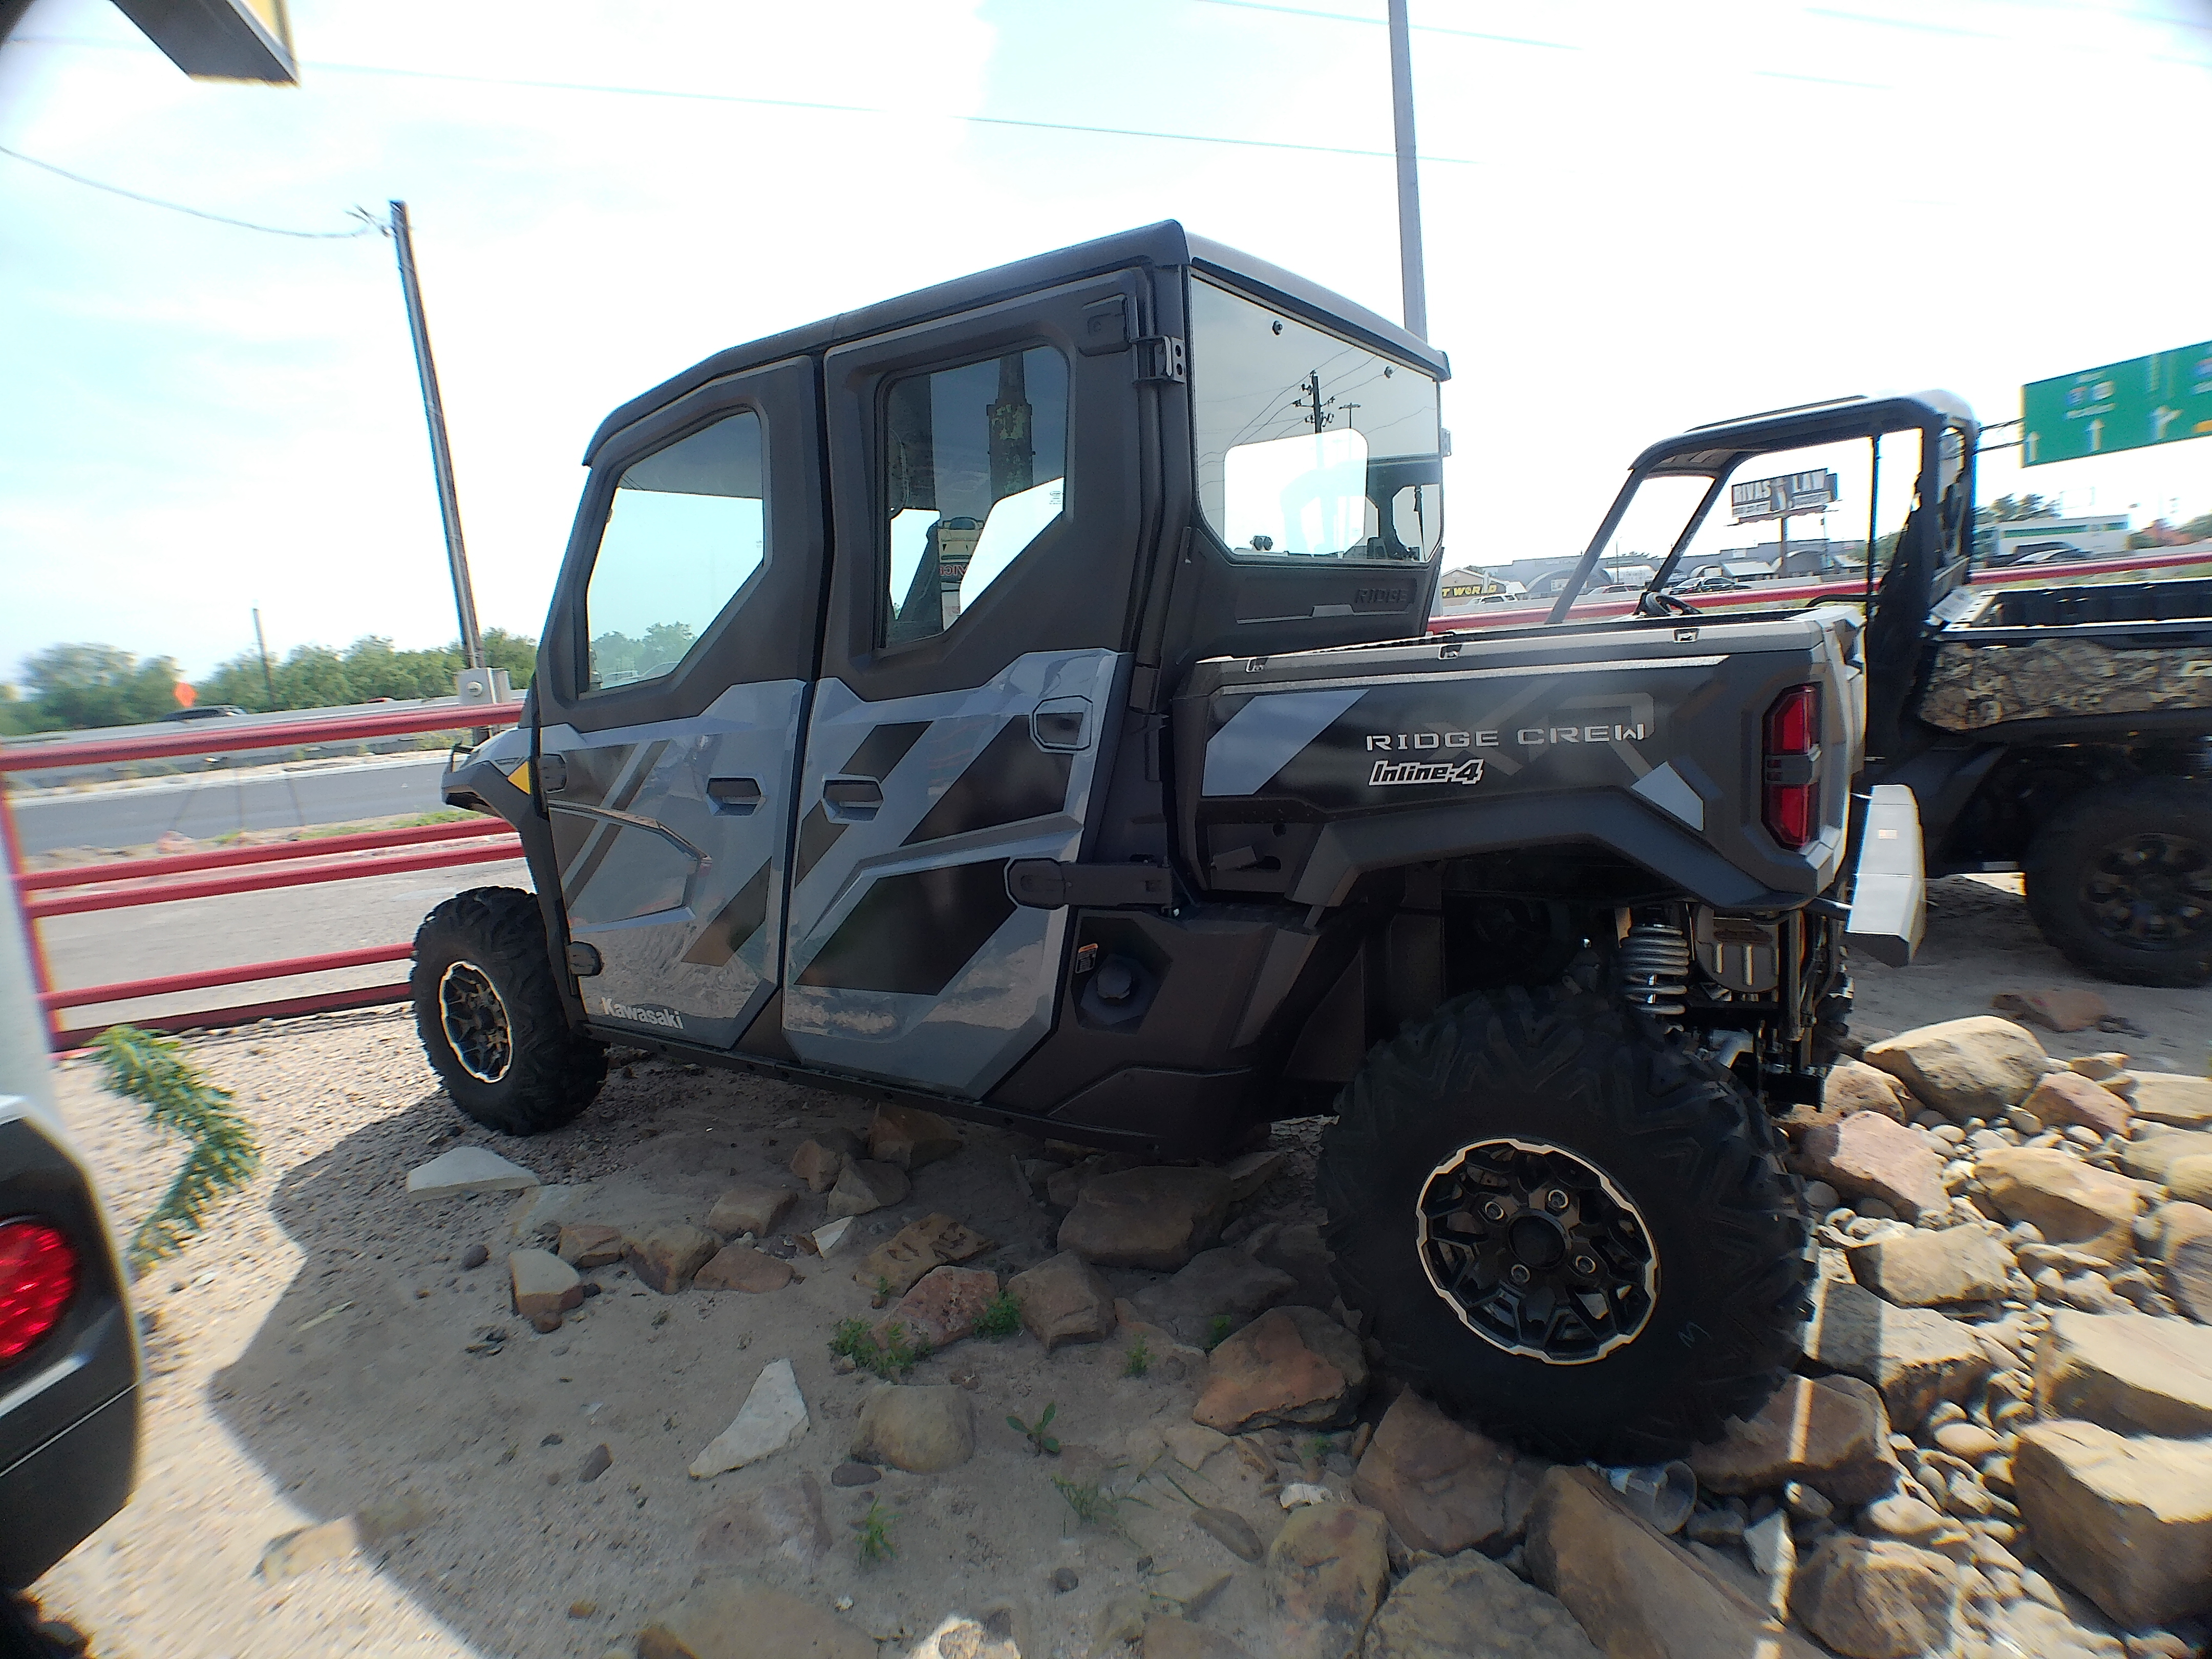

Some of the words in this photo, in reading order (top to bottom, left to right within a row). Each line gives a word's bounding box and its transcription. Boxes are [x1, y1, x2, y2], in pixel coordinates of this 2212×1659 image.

[1734, 480, 1771, 503] RIVAS
[1793, 471, 1826, 493] LAW
[1354, 588, 1409, 603] RIDGE
[1366, 729, 1499, 751] RIDGE
[1517, 723, 1644, 746] CREW
[1368, 758, 1484, 786] Inline-4
[601, 996, 684, 1030] Kawasaki
